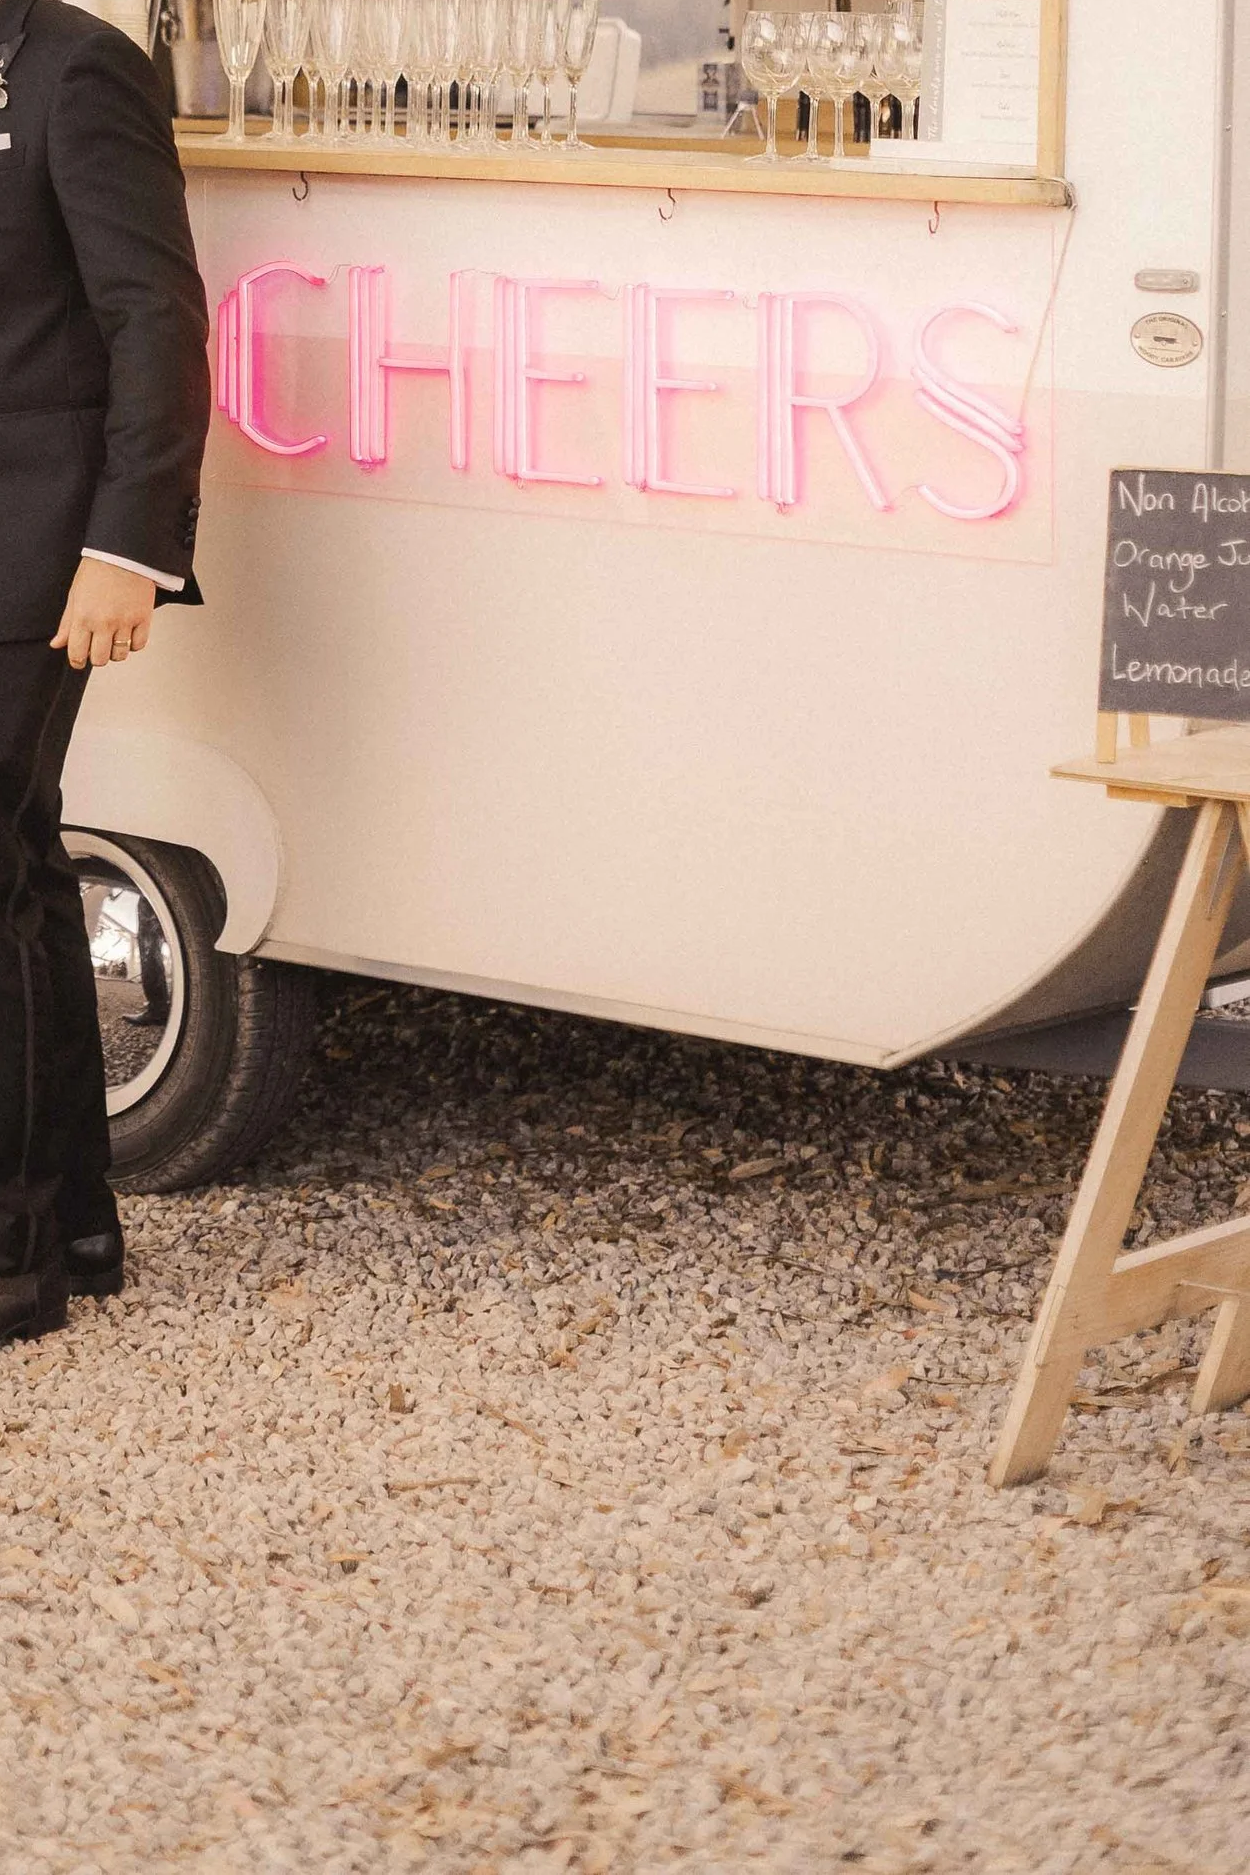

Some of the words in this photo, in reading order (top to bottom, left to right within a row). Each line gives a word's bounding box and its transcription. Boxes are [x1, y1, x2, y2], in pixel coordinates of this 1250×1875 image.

[217, 259, 1025, 519] CHEERS
[1118, 473, 1175, 517] Non
[1114, 540, 1210, 593] Orange
[1123, 581, 1228, 627] Water
[1112, 643, 1250, 691] Lemonade
